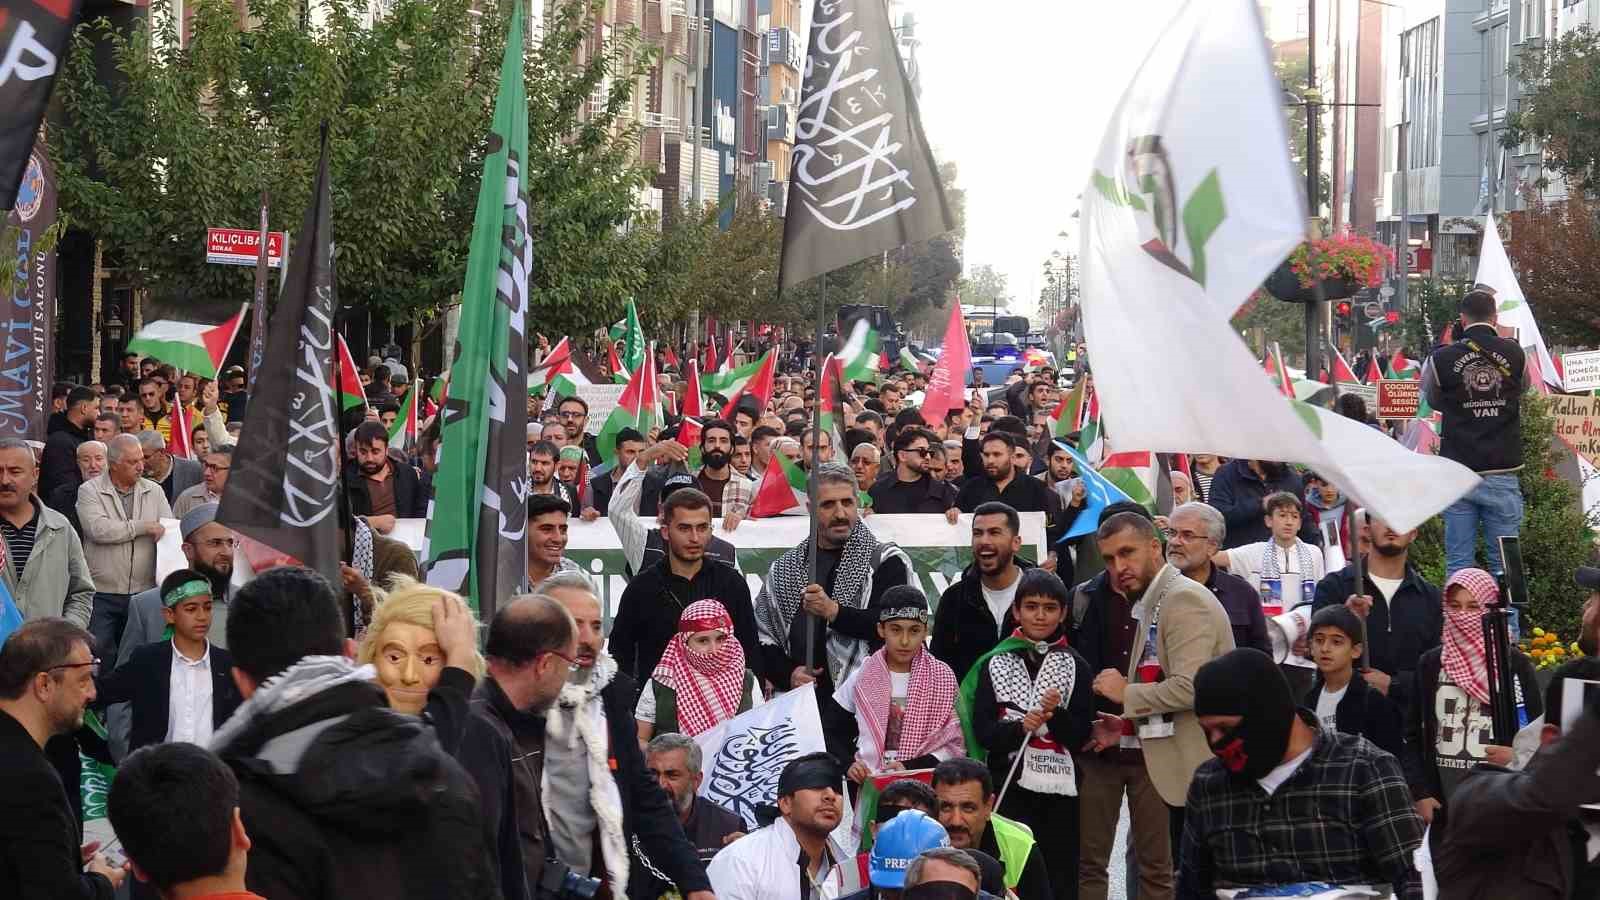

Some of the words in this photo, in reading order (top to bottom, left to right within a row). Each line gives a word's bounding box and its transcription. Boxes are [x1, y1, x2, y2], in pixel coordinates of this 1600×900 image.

[211, 233, 276, 248] KILIÇLIBAA
[34, 251, 46, 321] SALONU
[1384, 383, 1418, 391] ÇOCUKL
[1472, 407, 1500, 418] VAN
